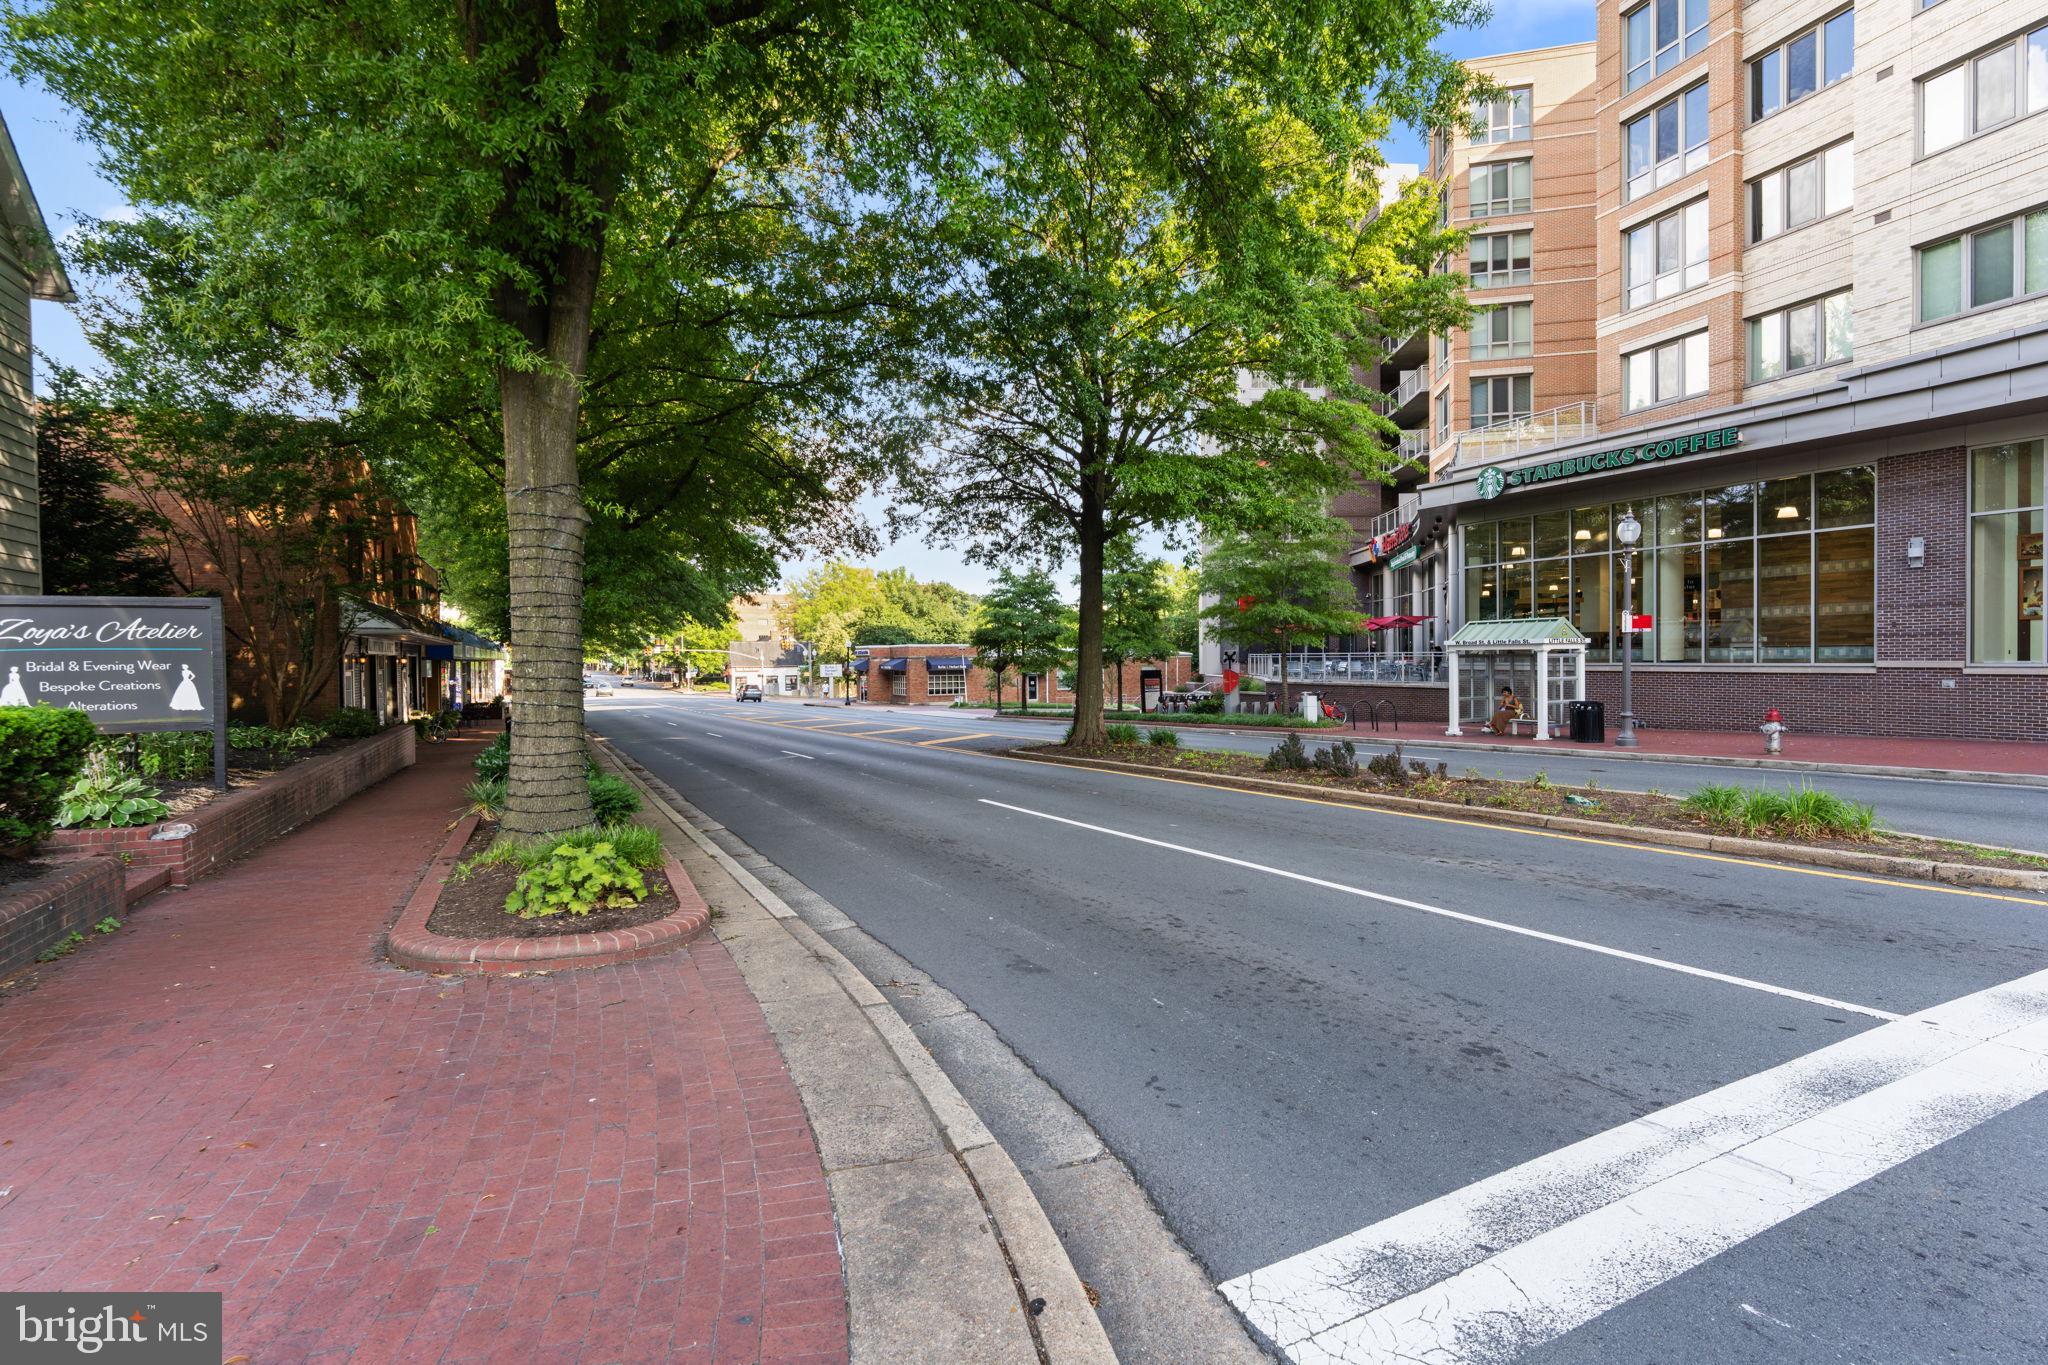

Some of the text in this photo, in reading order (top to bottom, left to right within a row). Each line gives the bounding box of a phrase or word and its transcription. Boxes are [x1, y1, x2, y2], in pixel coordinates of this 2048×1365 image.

[1510, 427, 1738, 486] STARBUCKS COFFEE
[0, 617, 203, 645] Zoya's Atelier
[26, 660, 172, 674] Bridal & Evening Wear
[39, 680, 161, 695] Bespoke Creations
[67, 701, 138, 711] Alterations
